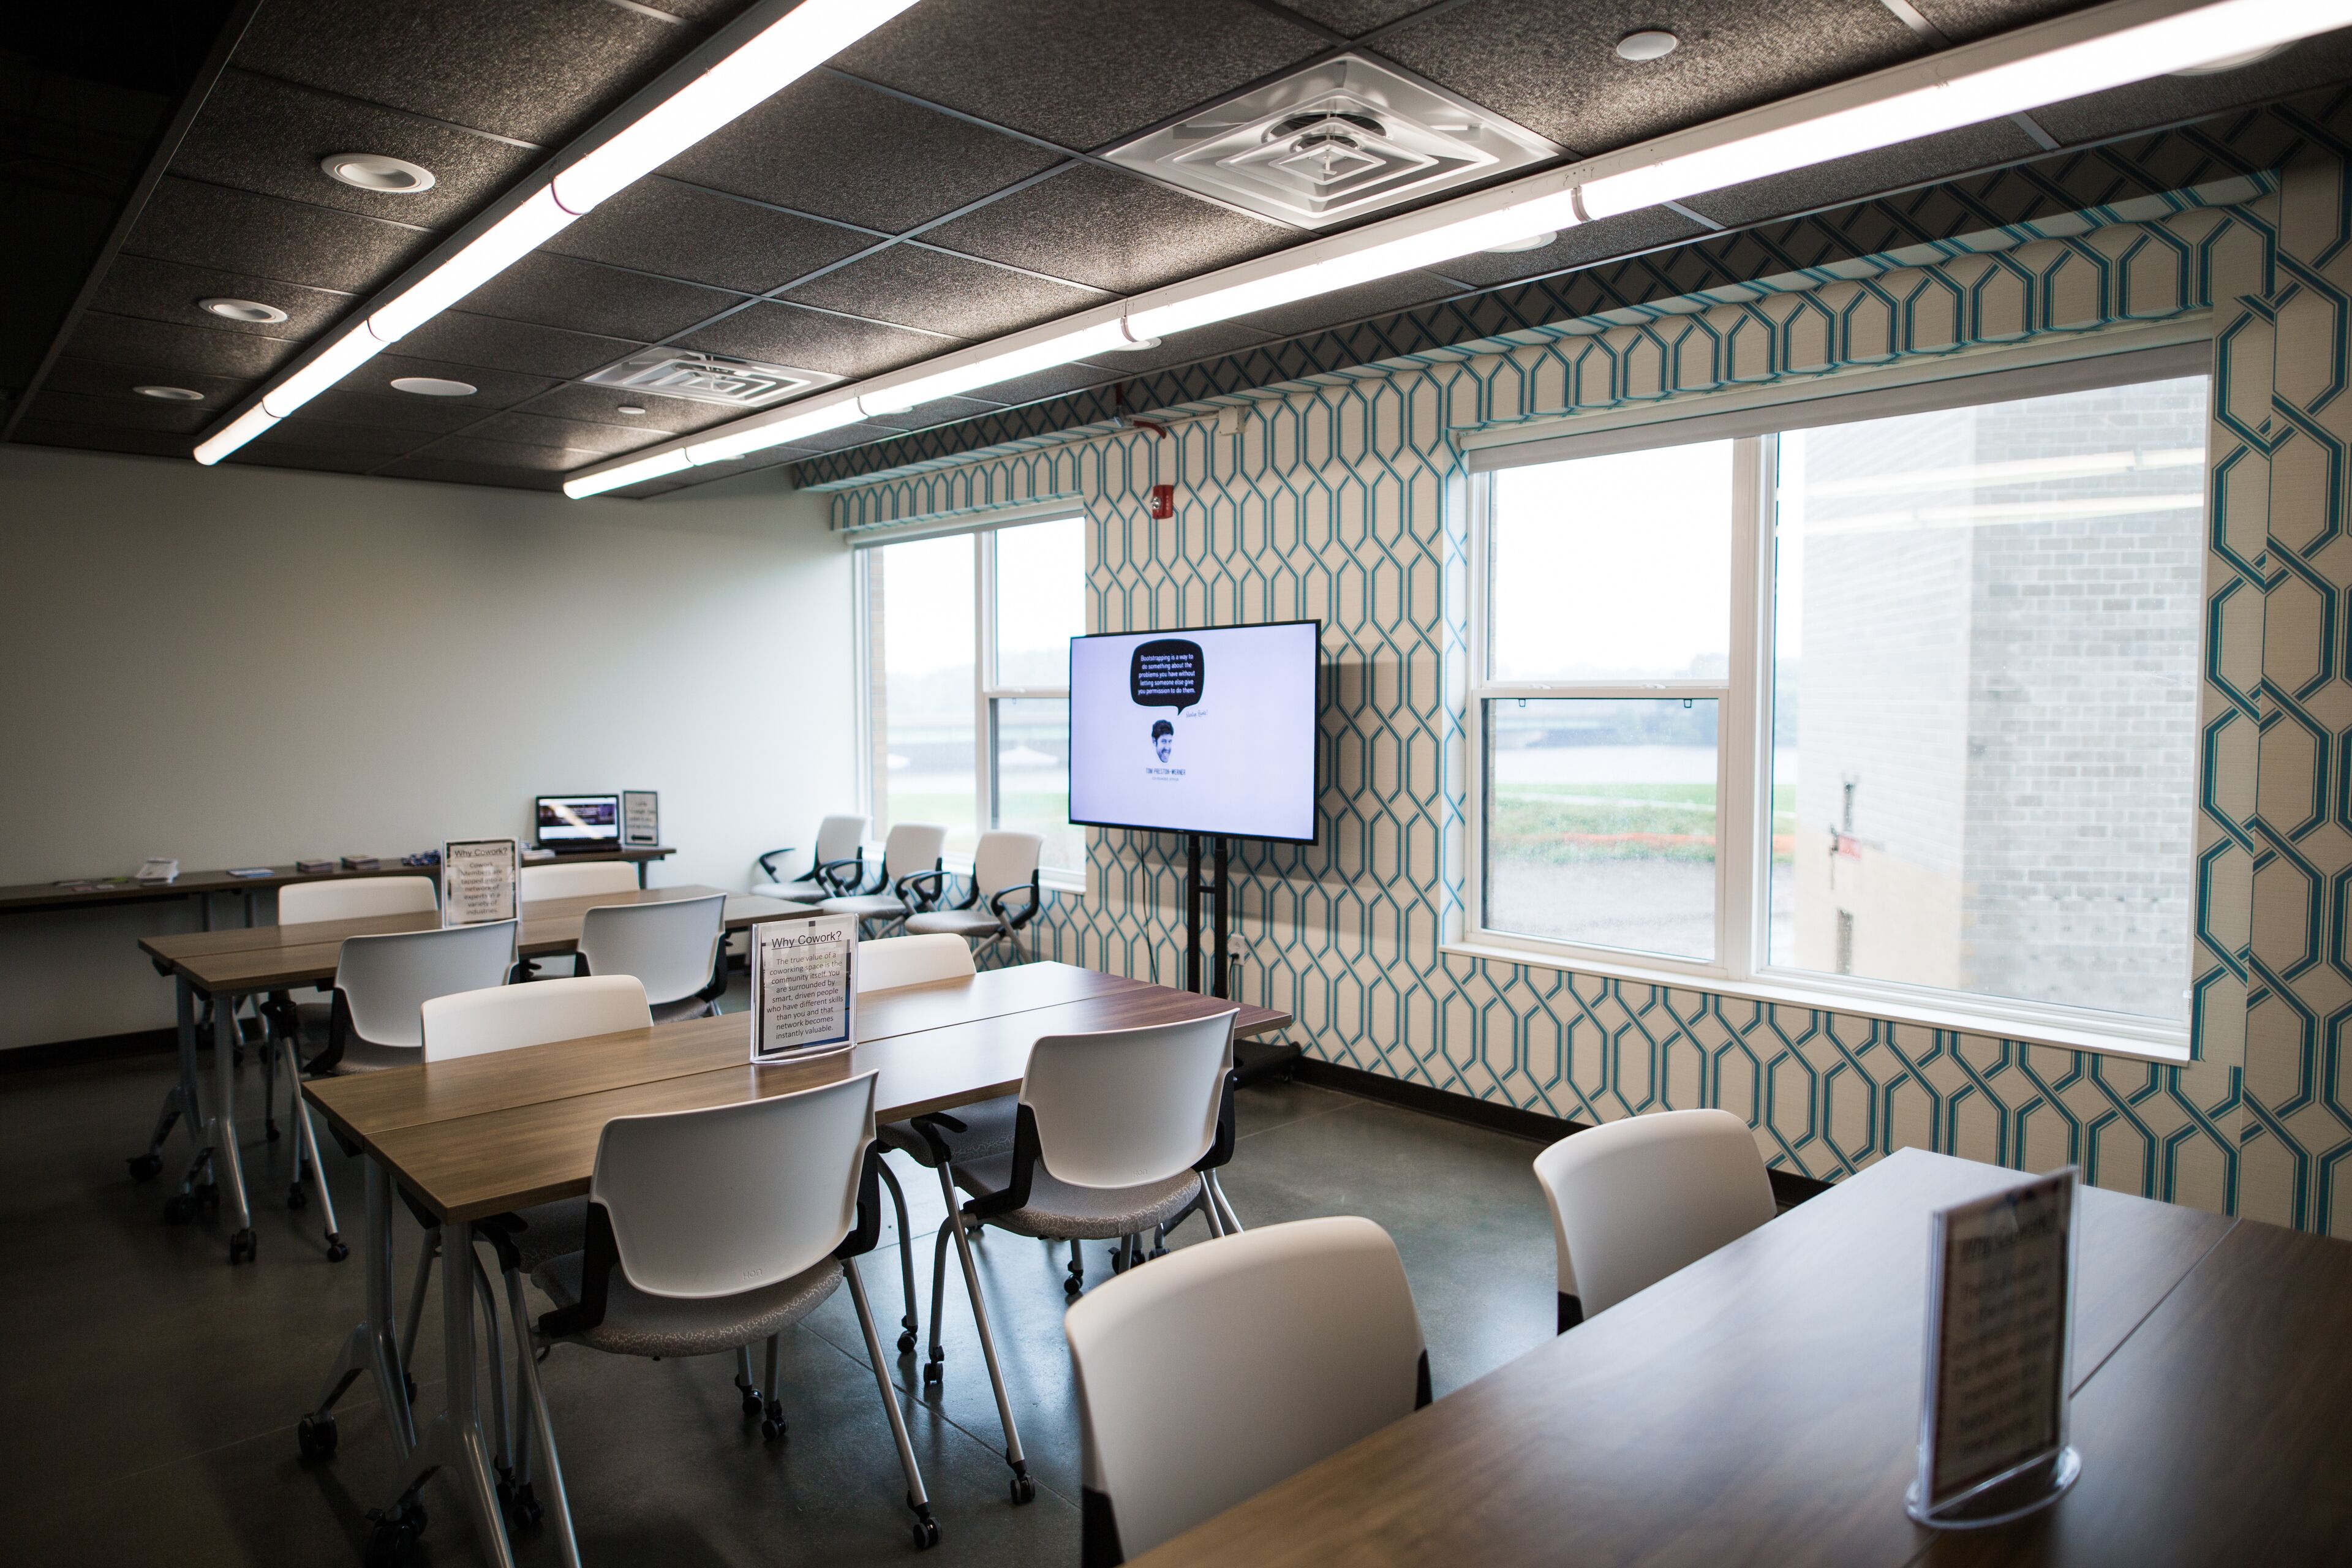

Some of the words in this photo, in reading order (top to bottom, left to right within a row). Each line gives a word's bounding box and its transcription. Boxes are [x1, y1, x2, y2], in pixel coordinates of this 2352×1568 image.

[475, 847, 508, 856] Cowork?
[772, 937, 794, 949] Why
[798, 930, 842, 945] Cowork?
[770, 966, 803, 976] coworking
[772, 973, 809, 985] community
[810, 970, 827, 979] itself.
[788, 979, 826, 992] surrounded
[772, 995, 793, 1003] smart,
[816, 987, 839, 997] people
[799, 999, 827, 1008] different
[829, 995, 843, 1004] skills
[776, 1020, 804, 1030] network
[805, 1016, 834, 1025] becomes
[776, 1029, 804, 1039] instantly
[805, 1025, 834, 1035] valuable.
